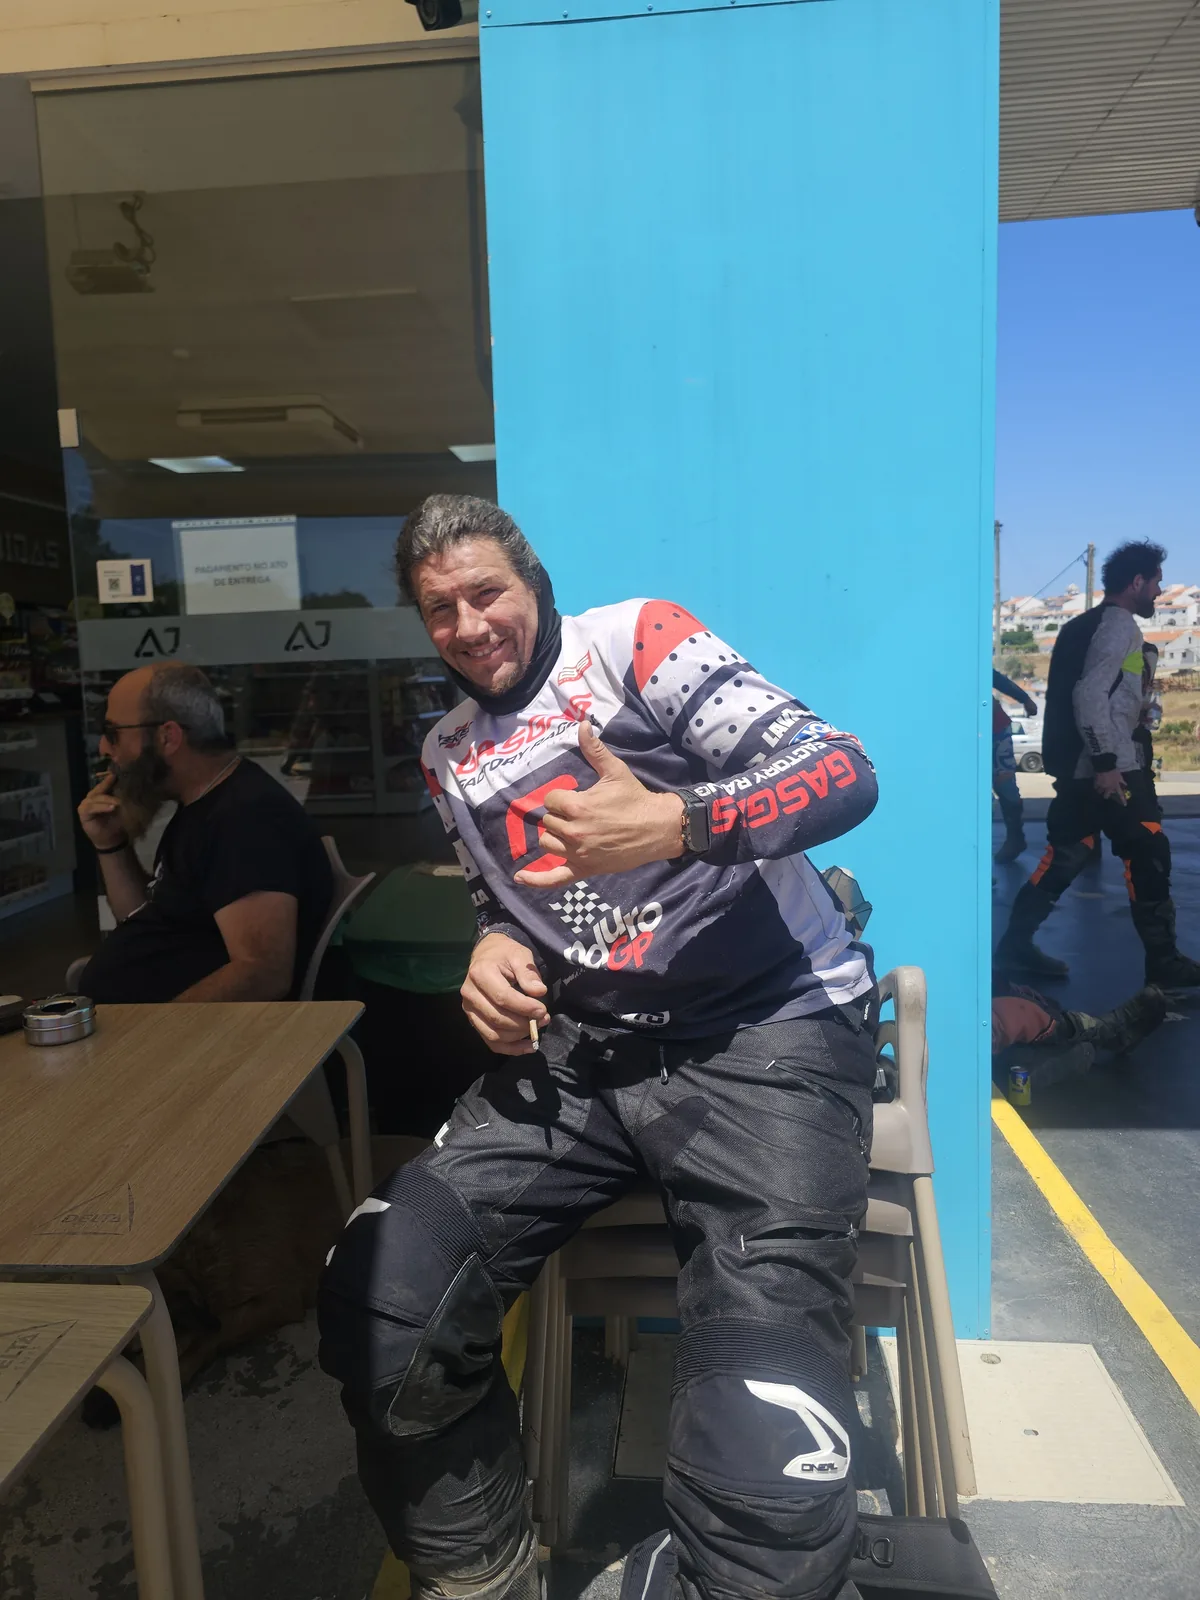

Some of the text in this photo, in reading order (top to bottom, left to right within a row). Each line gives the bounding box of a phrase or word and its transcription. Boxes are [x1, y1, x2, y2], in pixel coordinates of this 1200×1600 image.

[213, 575, 271, 587] DE ENTREGA
[459, 747, 529, 790] FACTORY
[755, 740, 828, 783] FACTORY
[607, 930, 654, 971] GP
